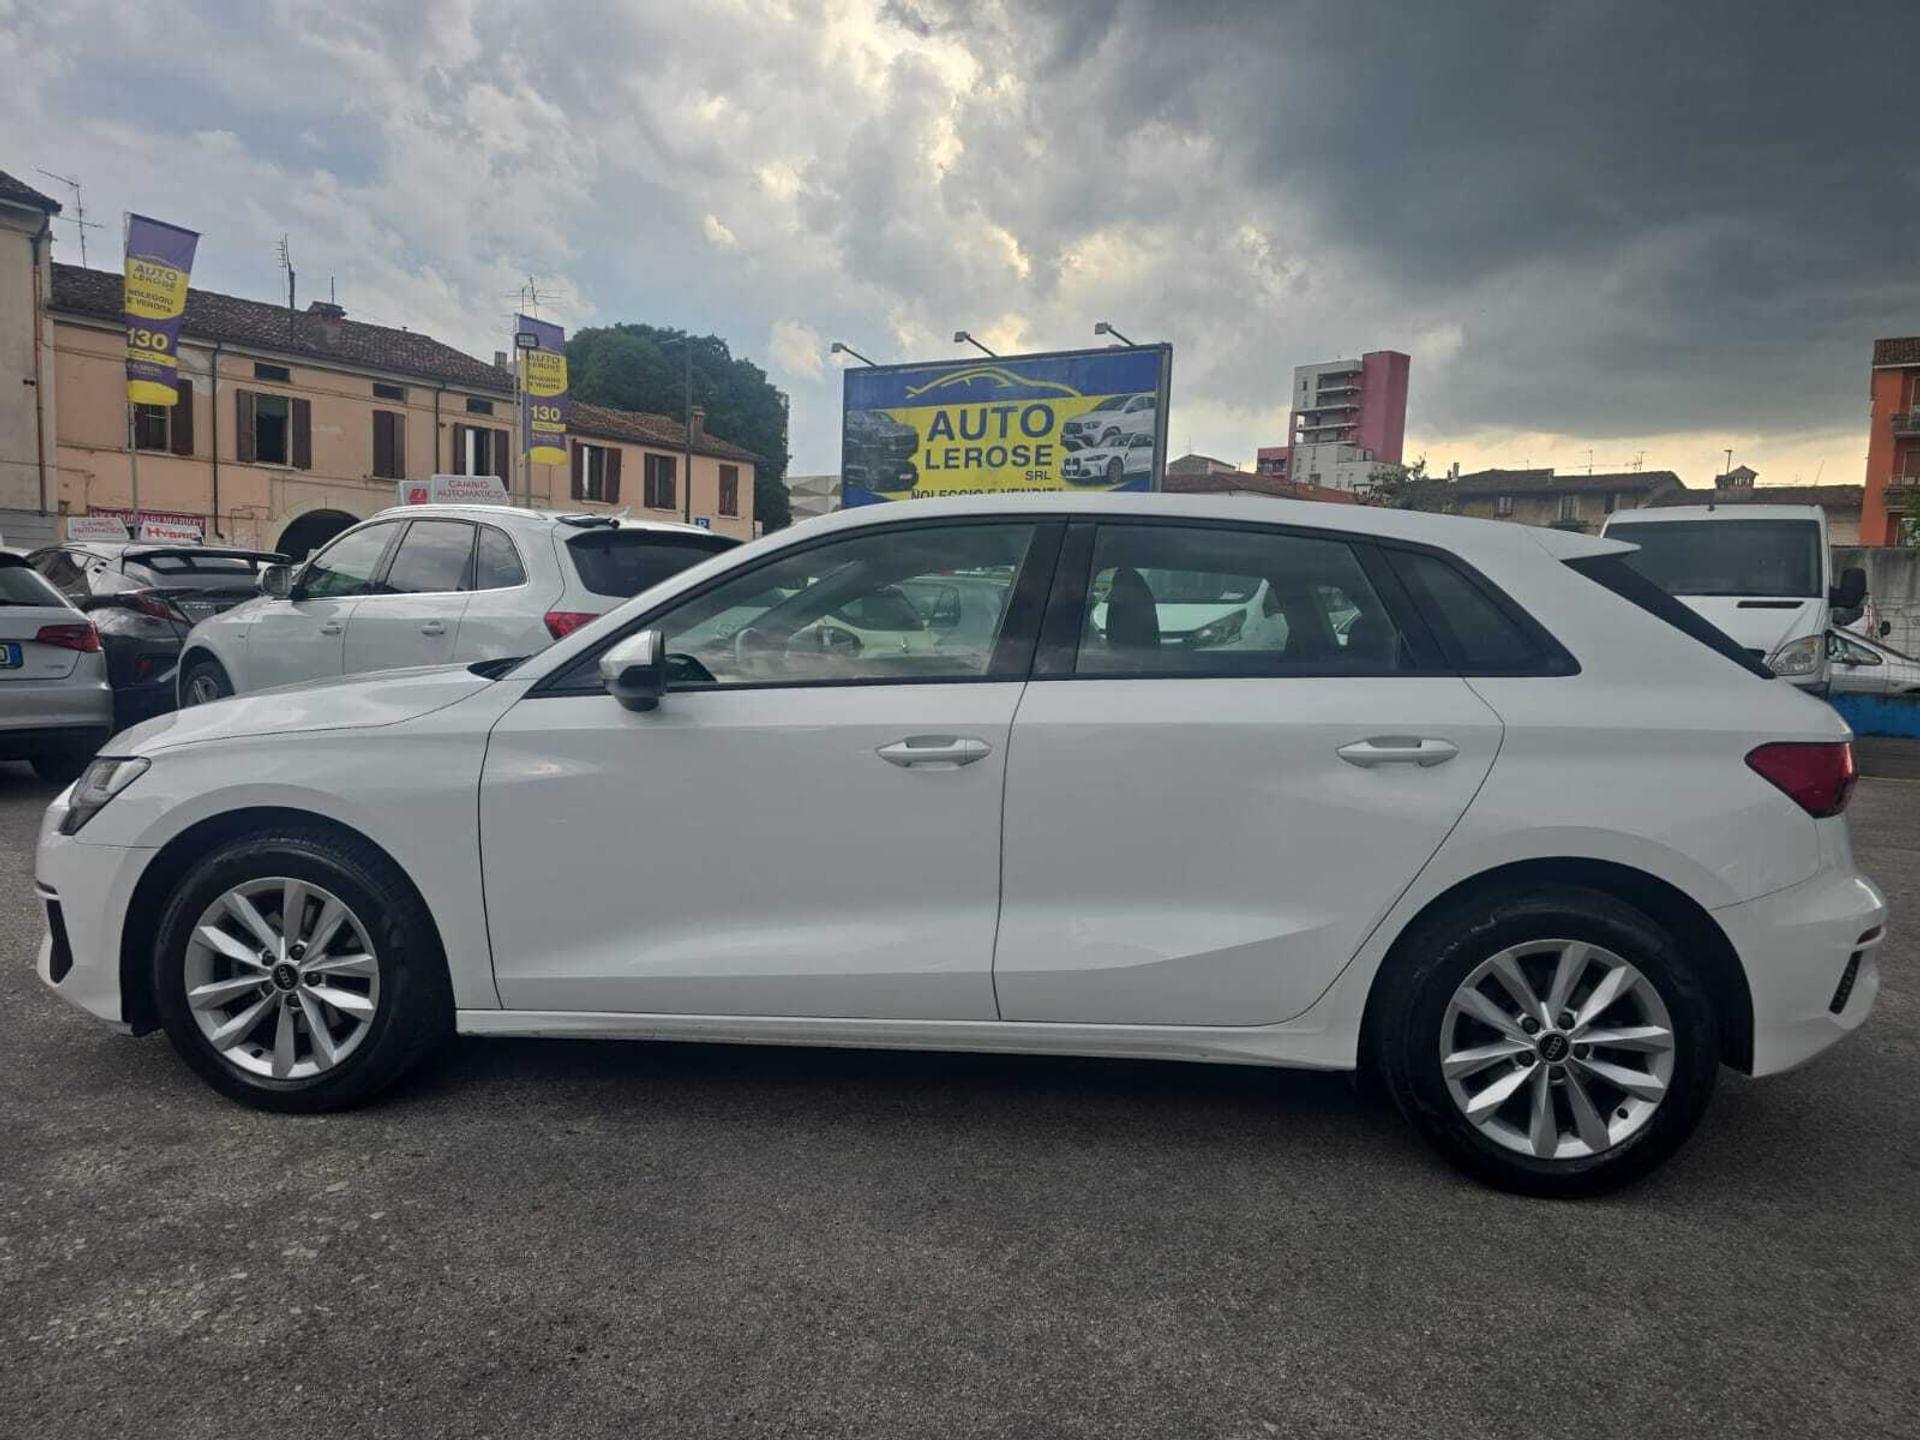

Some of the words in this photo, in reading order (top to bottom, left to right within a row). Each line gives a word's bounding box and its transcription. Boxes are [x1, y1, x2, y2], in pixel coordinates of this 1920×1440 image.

[134, 264, 177, 280] AUTO
[127, 328, 168, 350] 130
[530, 405, 561, 421] 130
[926, 403, 1055, 442] AUTO
[925, 444, 1053, 470] LEROSE
[1025, 470, 1052, 481] SRL
[437, 489, 504, 498] AUTOMATICO
